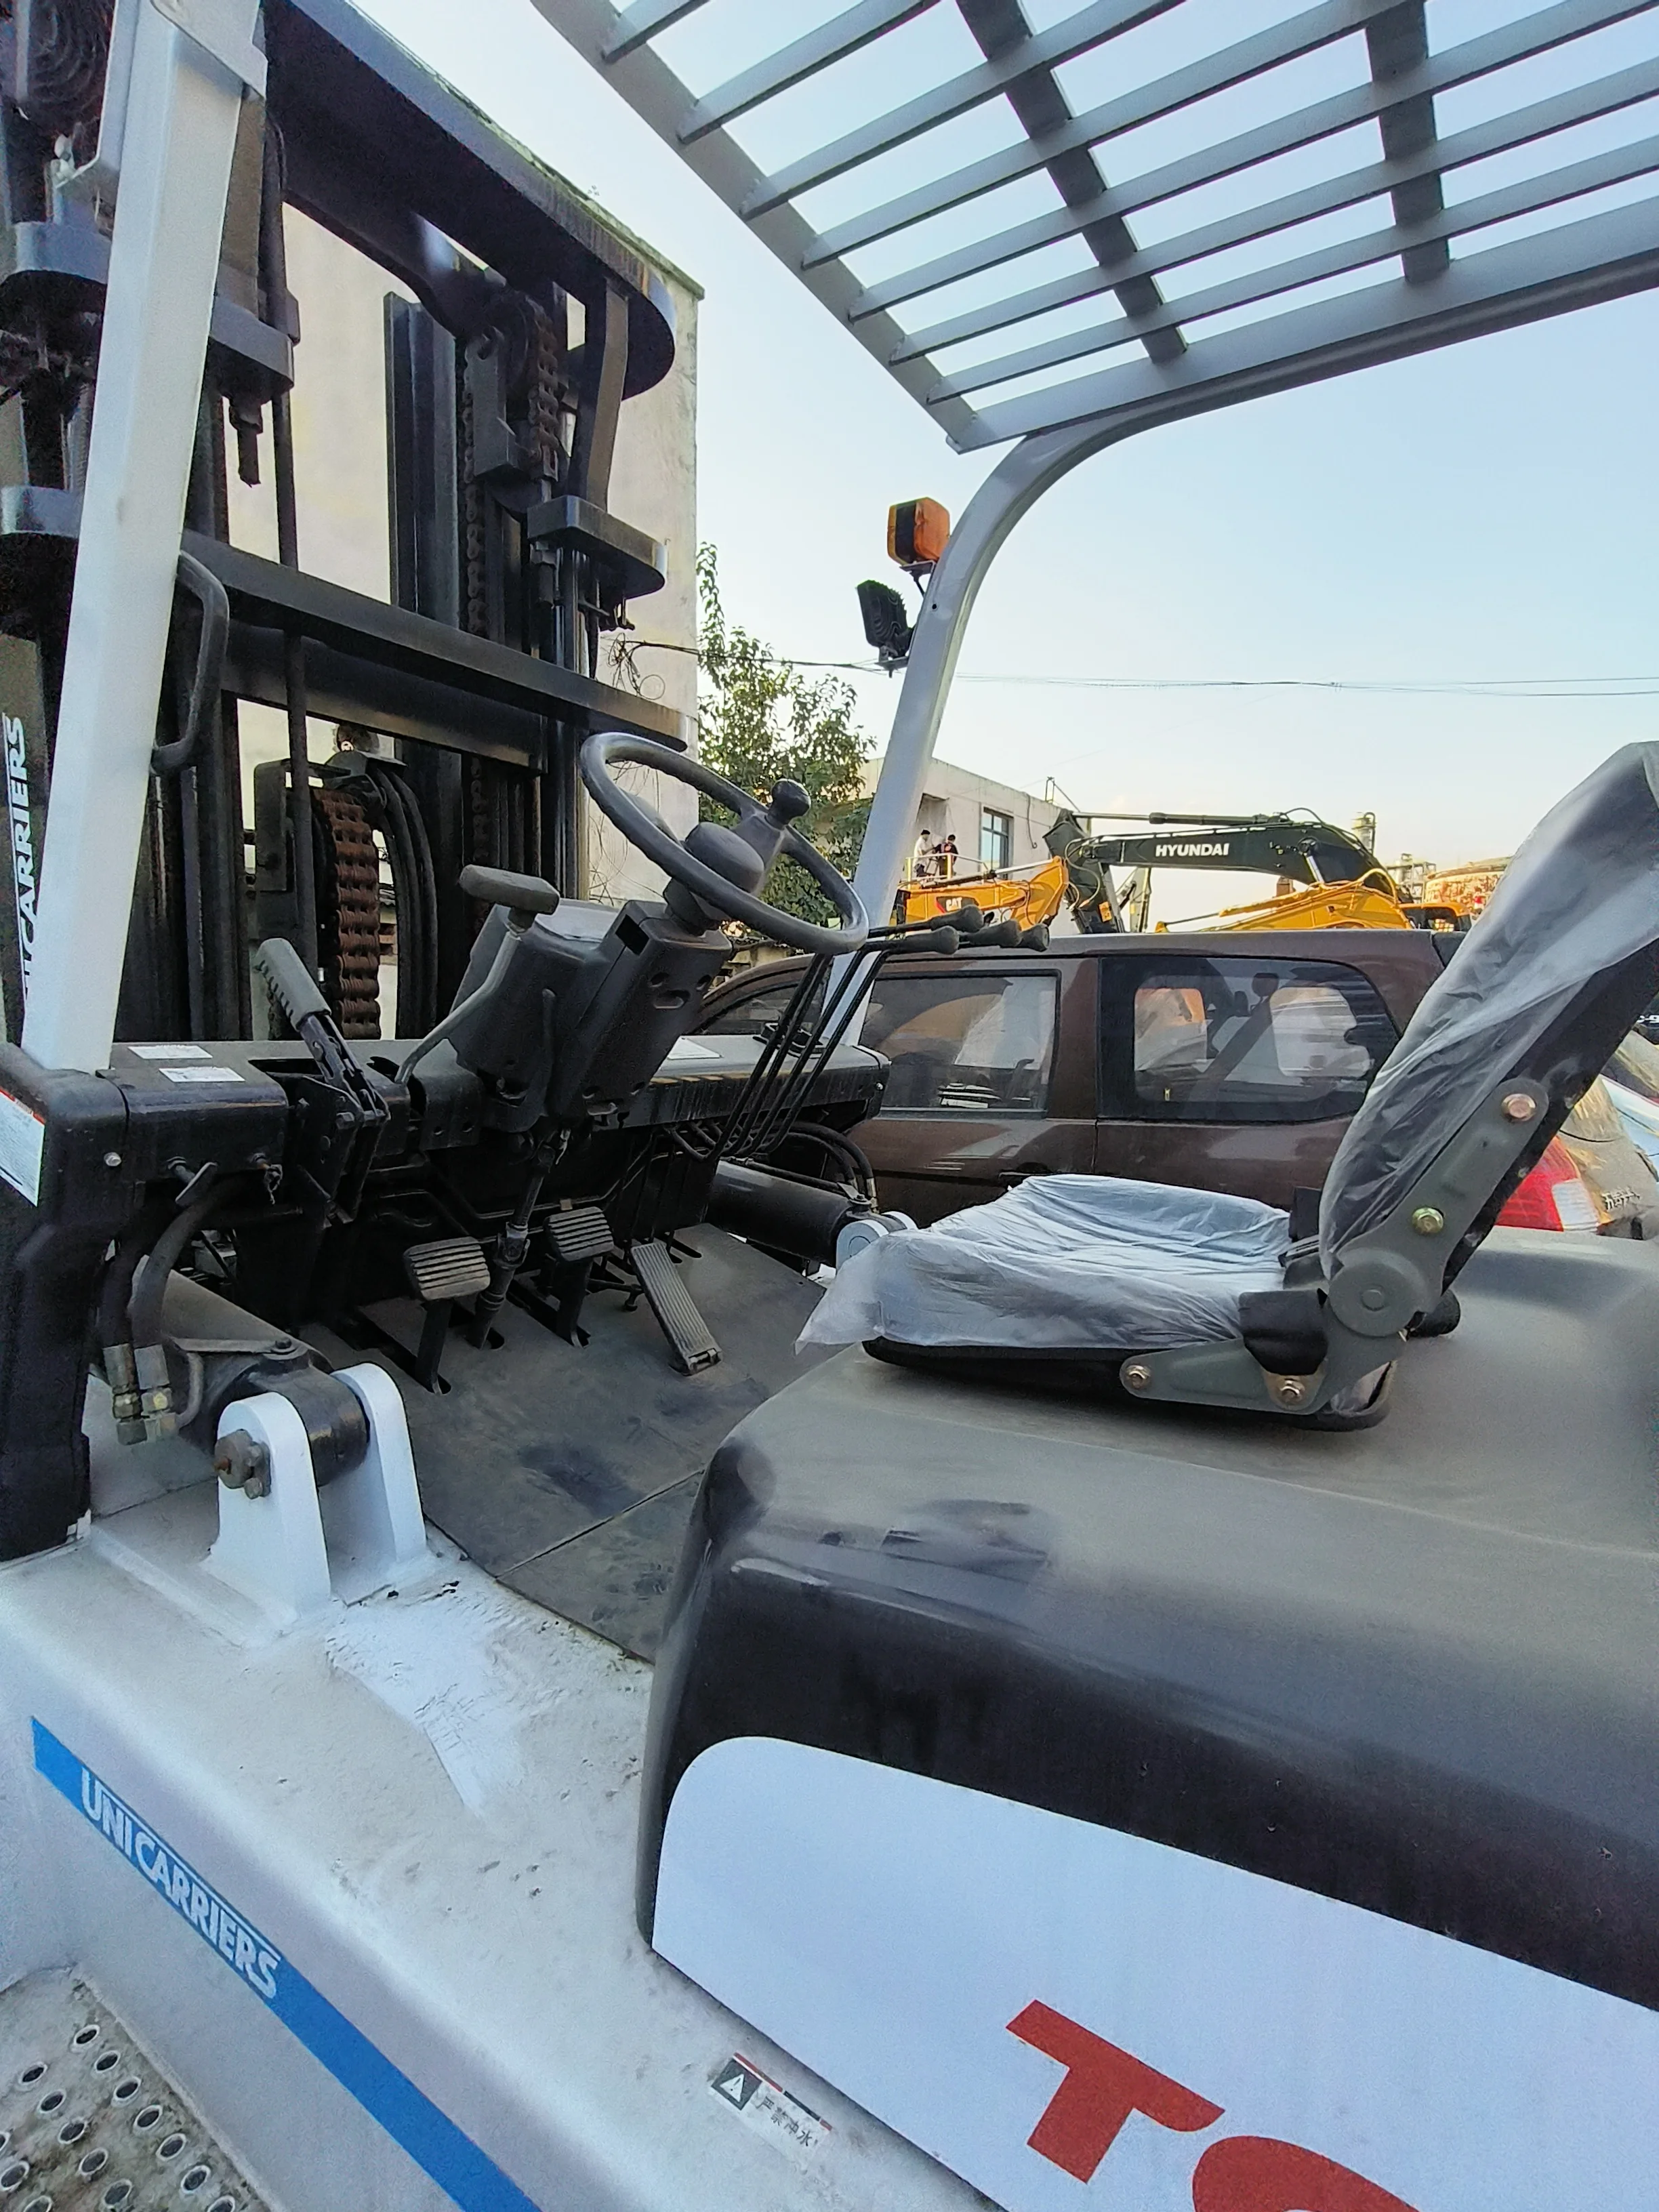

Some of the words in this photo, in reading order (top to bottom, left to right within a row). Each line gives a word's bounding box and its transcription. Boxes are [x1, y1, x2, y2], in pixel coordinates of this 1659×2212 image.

[1155, 843, 1230, 857] HYUNDAI
[946, 897, 962, 912] CAT
[81, 1767, 281, 1999] UNICARRIERS
